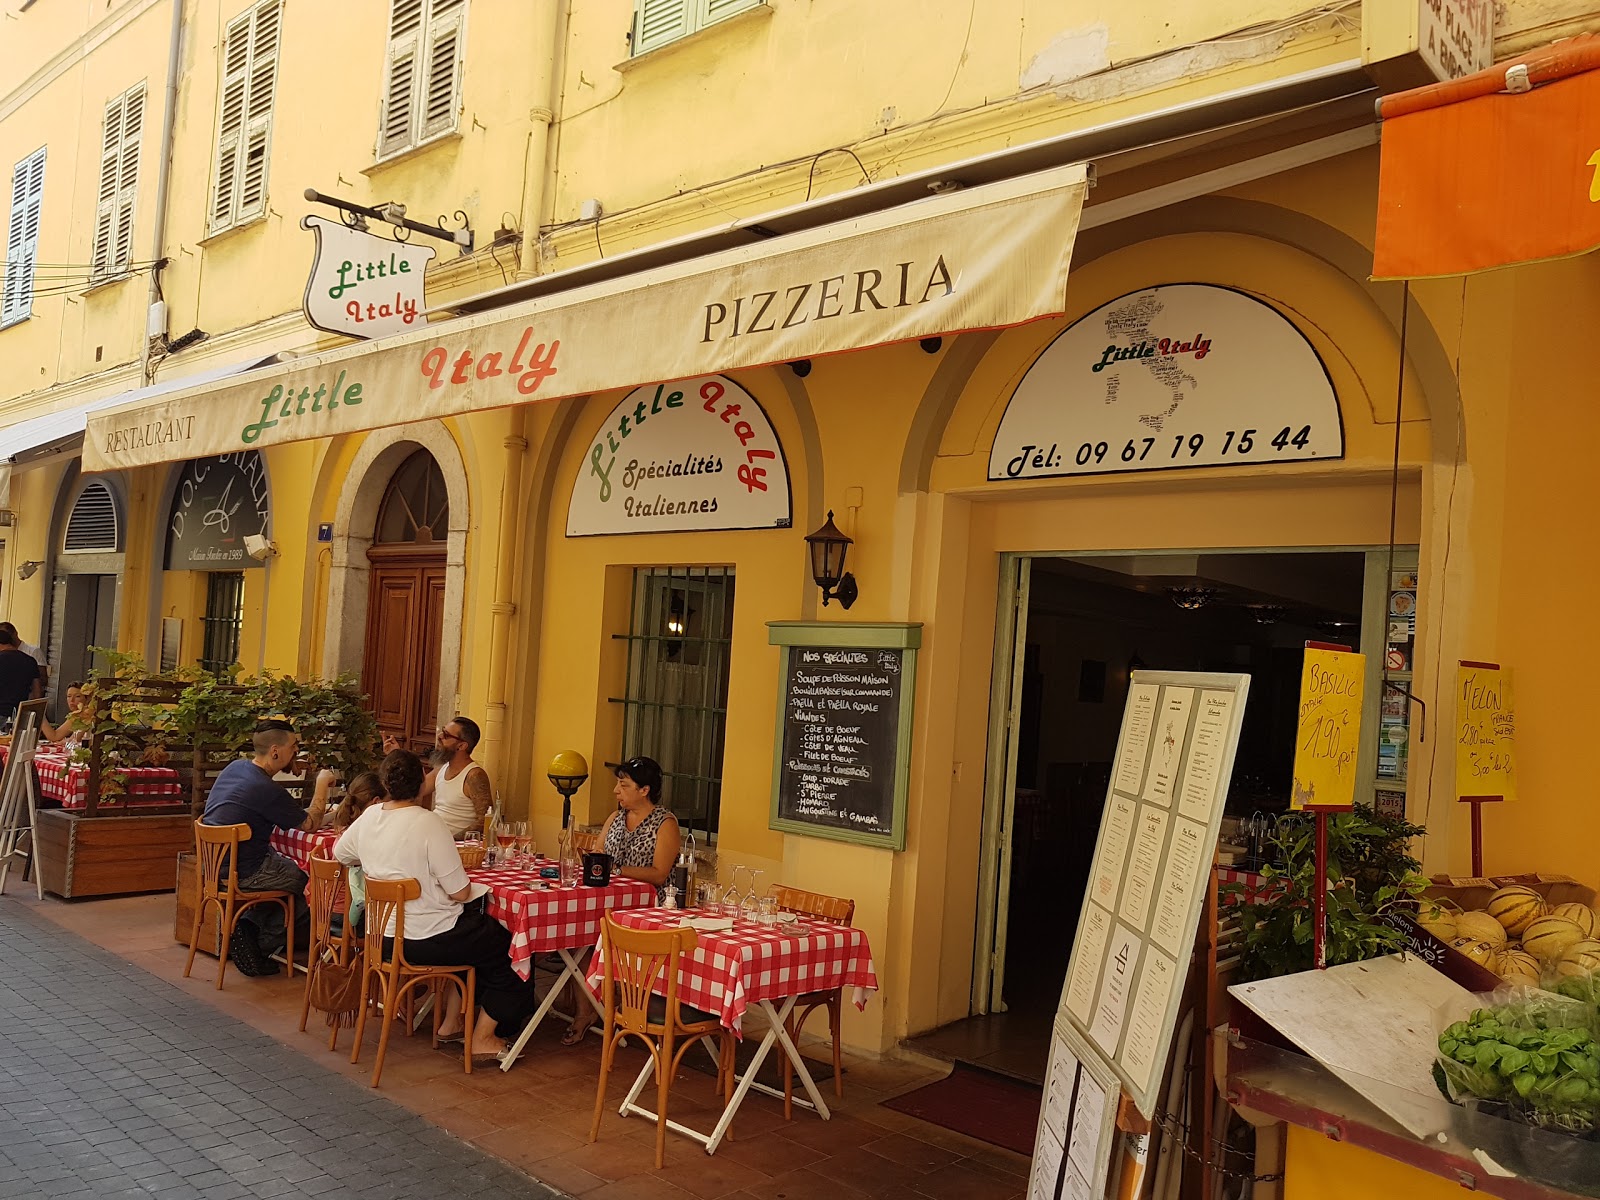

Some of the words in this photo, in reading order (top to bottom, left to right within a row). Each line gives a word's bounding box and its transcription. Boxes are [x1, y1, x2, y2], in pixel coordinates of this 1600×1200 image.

[328, 252, 411, 299] Little
[345, 292, 419, 325] Italy
[104, 415, 196, 454] RESTAURANT
[241, 369, 364, 444] Little
[421, 326, 561, 395] Italy
[700, 253, 957, 343] PIZZERIA
[1092, 341, 1155, 373] Little
[1158, 333, 1212, 360] Italy
[590, 383, 684, 502] Little
[699, 381, 776, 493] Italy
[1007, 443, 1062, 477] Tél:
[1075, 441, 1110, 466] 09
[1120, 437, 1156, 462] 67
[1170, 433, 1205, 459] 19
[1221, 429, 1257, 456] 15
[1270, 424, 1312, 452] 44
[622, 453, 723, 490] Spécialités
[624, 494, 719, 518] Italiennes
[228, 549, 243, 560] 1989
[1310, 663, 1357, 698] BASILIC
[1463, 672, 1502, 720] MELON
[1503, 753, 1512, 773] 2
[1387, 909, 1414, 932] Melons
